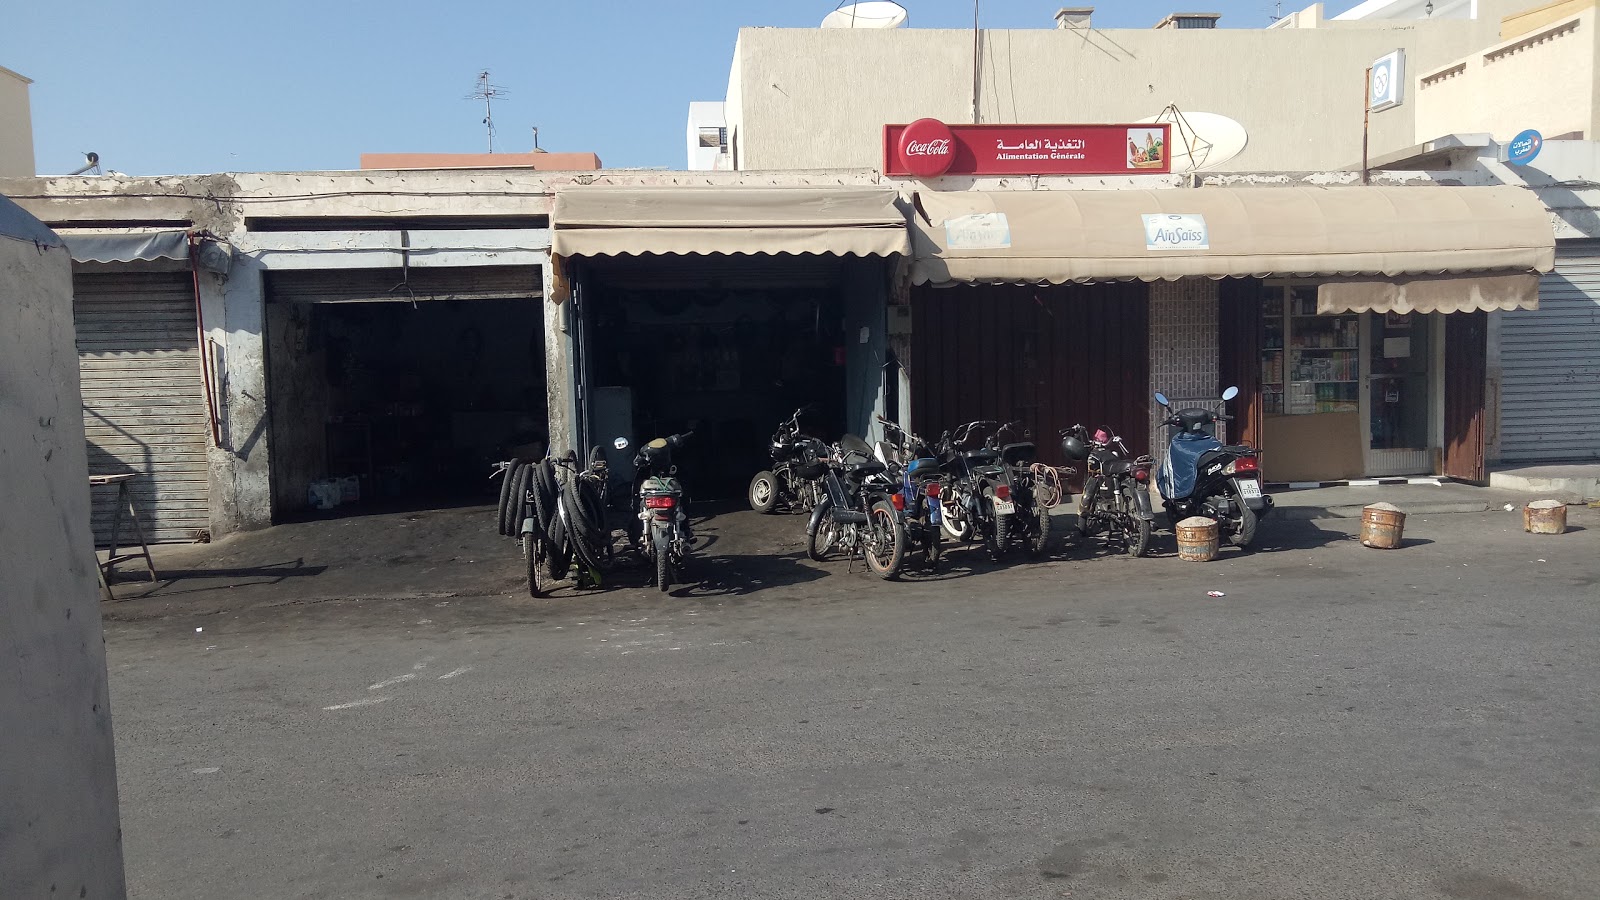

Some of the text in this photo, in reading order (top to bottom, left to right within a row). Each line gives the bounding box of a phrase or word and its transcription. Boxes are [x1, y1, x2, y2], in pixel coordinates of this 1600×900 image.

[1044, 138, 1085, 152] التغذية
[996, 152, 1085, 160] Alimentation Générale
